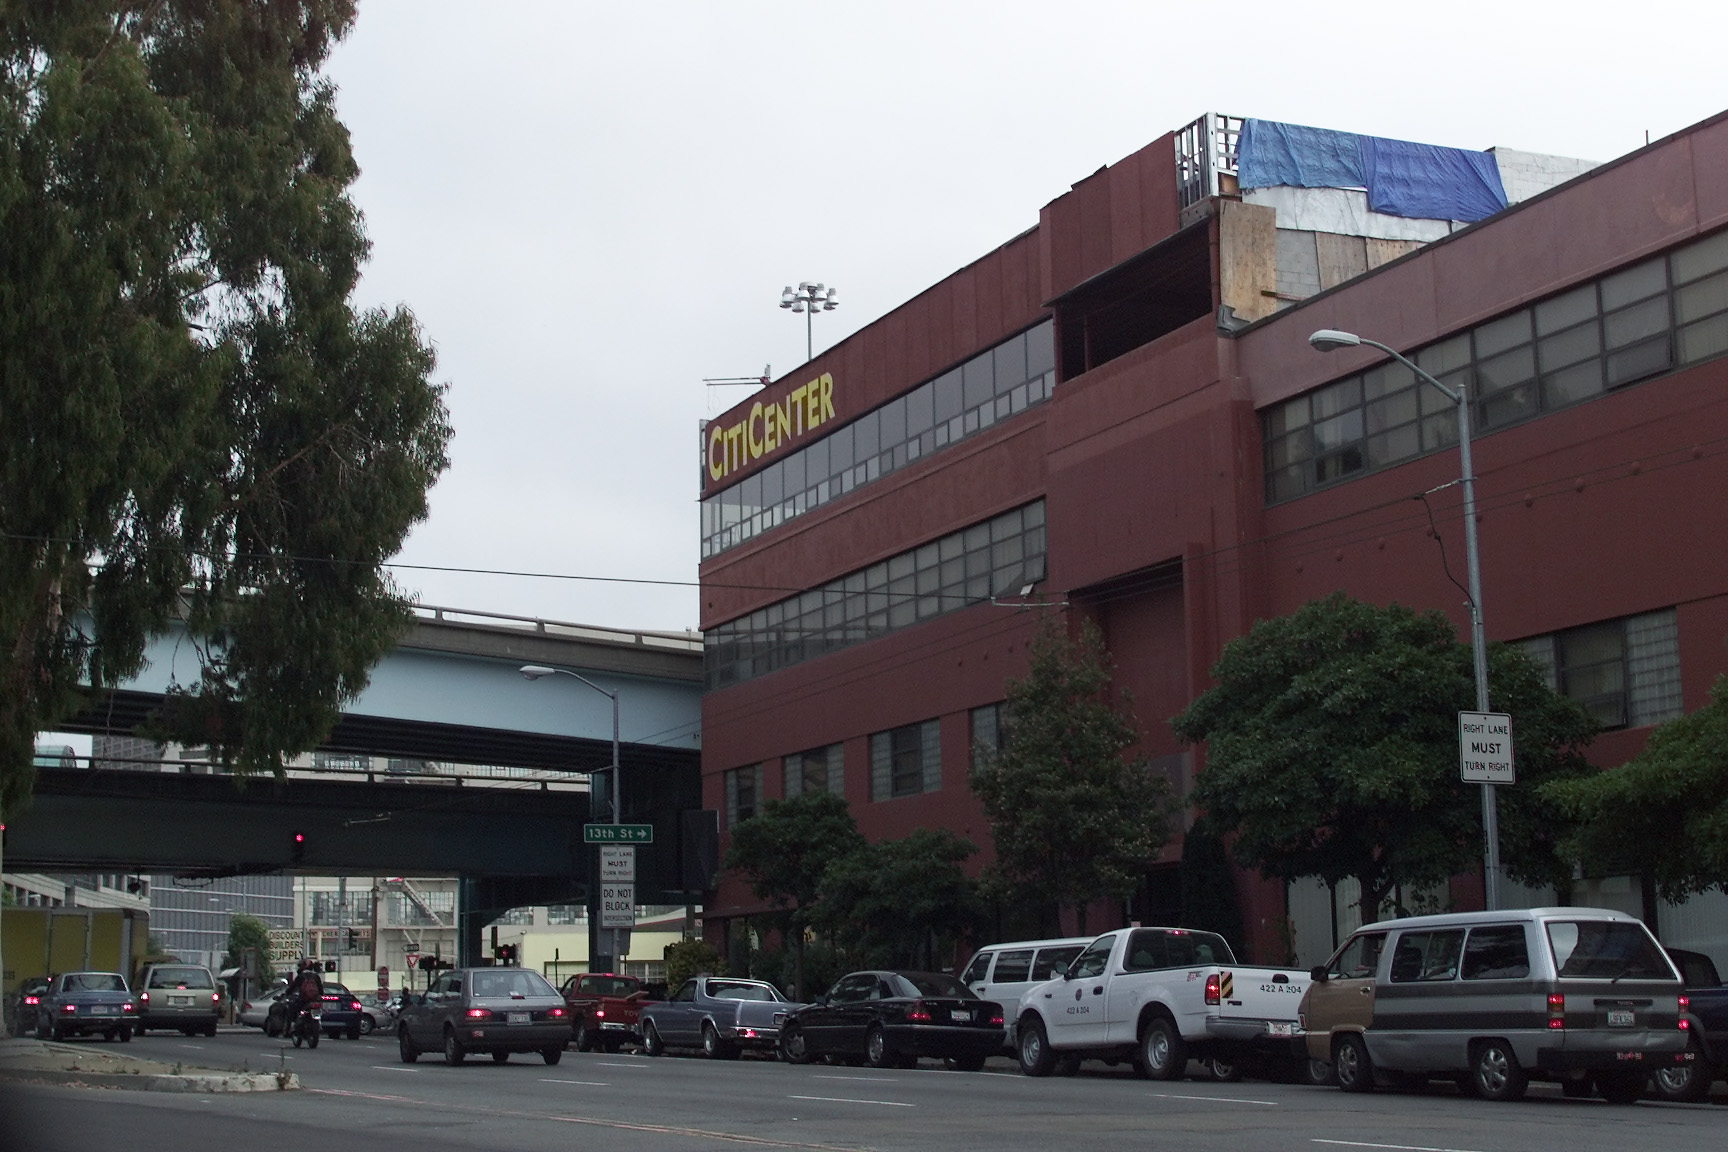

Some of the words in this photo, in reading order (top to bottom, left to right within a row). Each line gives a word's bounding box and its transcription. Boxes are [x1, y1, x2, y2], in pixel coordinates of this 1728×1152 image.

[709, 372, 835, 481] CITICENTER
[1463, 723, 1484, 734] RIGHT
[1488, 725, 1508, 735] LANE
[1471, 742, 1501, 754] MUST
[1465, 761, 1486, 771] TURN
[1488, 762, 1509, 772] RIGHT
[589, 828, 614, 838] 13th
[620, 828, 633, 838] St
[603, 889, 614, 898] DO
[617, 889, 632, 898] NOT
[605, 901, 631, 911] BLOCK
[269, 930, 304, 940] DISCOUNT
[270, 940, 304, 949] BUILDERS
[269, 949, 304, 961] SUPPLY
[1260, 984, 1276, 993] 422
[1278, 985, 1284, 993] A
[624, 1009, 640, 1018] TOY
